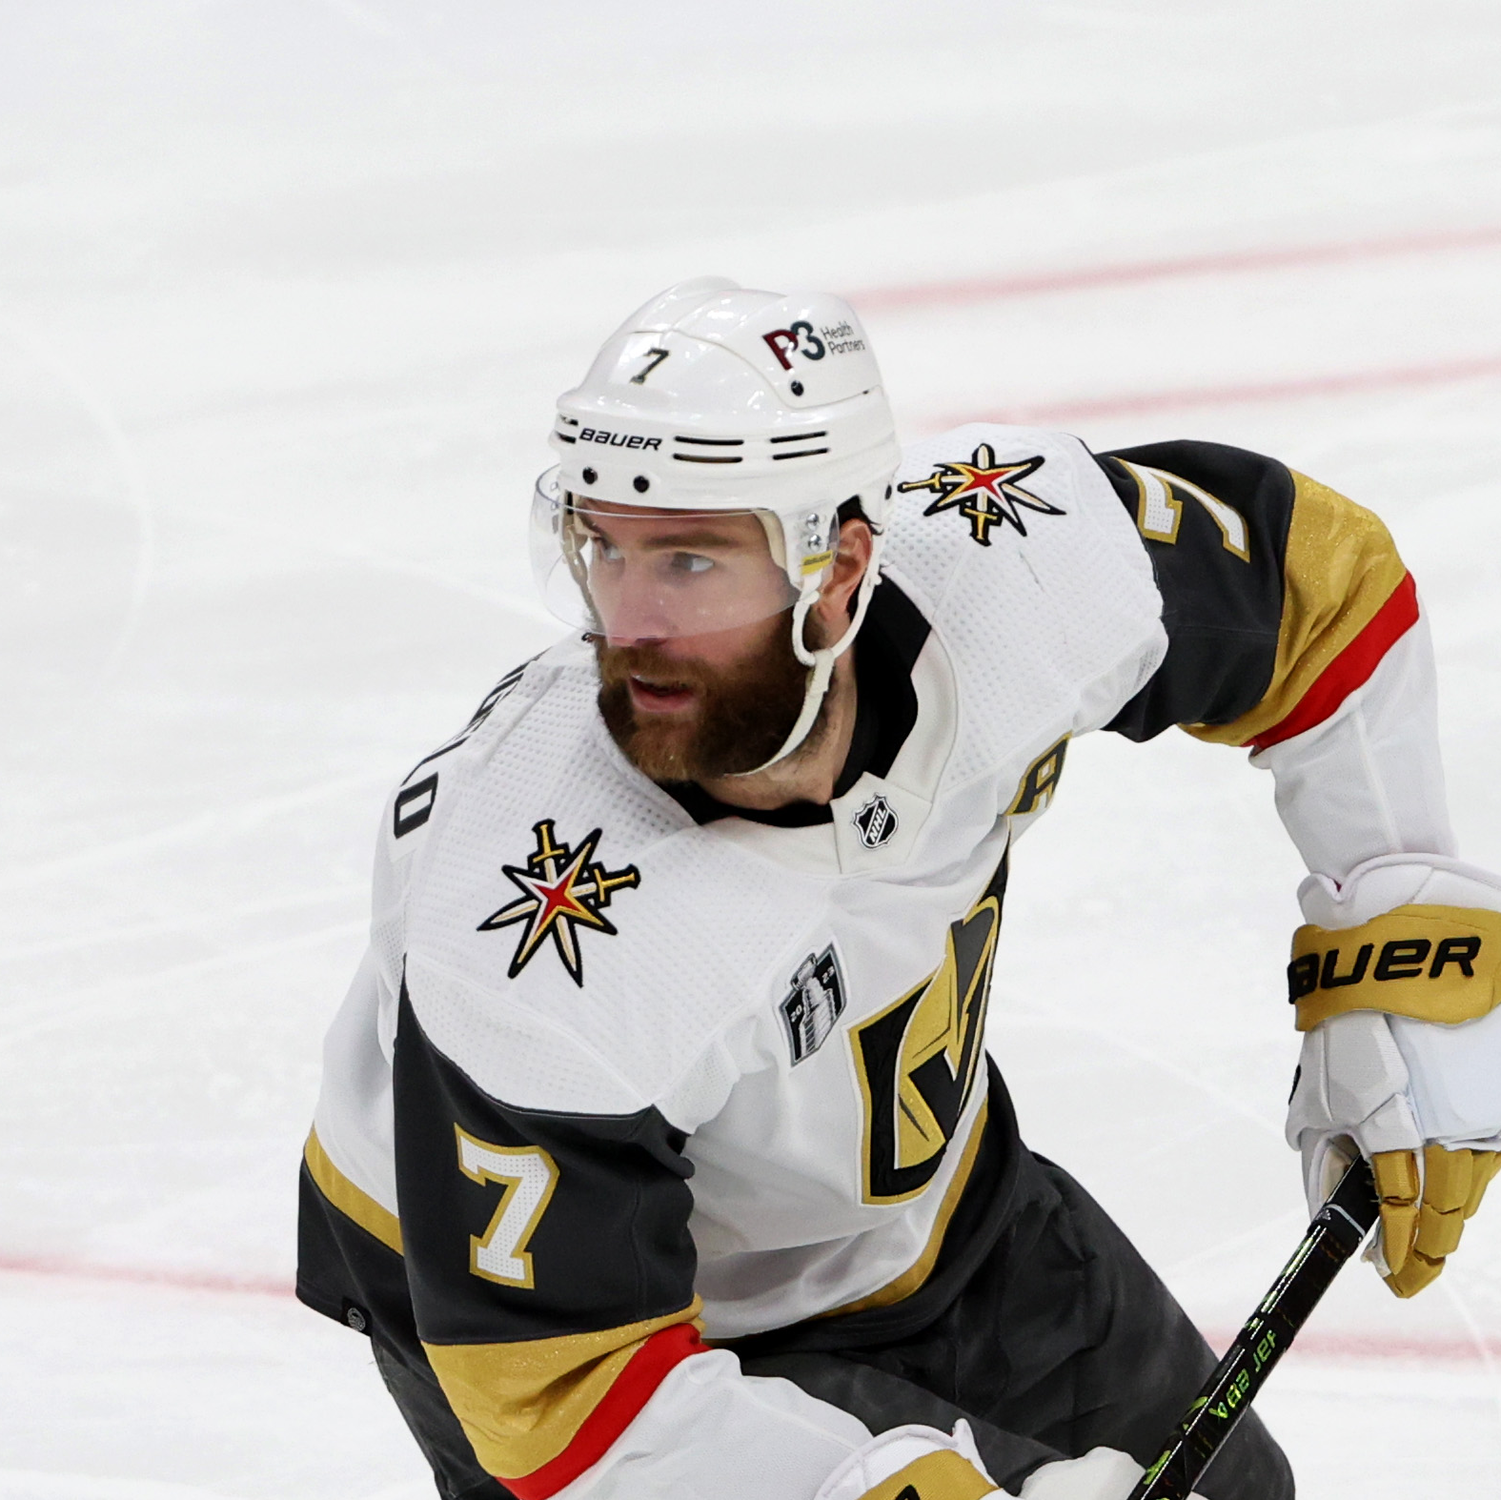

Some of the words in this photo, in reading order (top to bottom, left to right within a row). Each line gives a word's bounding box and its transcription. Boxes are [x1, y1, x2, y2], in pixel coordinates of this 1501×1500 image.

[762, 320, 826, 371] P3
[820, 320, 855, 340] Health
[827, 339, 866, 355] Partners
[628, 347, 670, 385] 7
[579, 427, 663, 451] BAUER
[1109, 455, 1251, 564] 7
[869, 808, 887, 843] NHL
[1287, 936, 1482, 1005] AUER
[453, 1122, 561, 1290] 7
